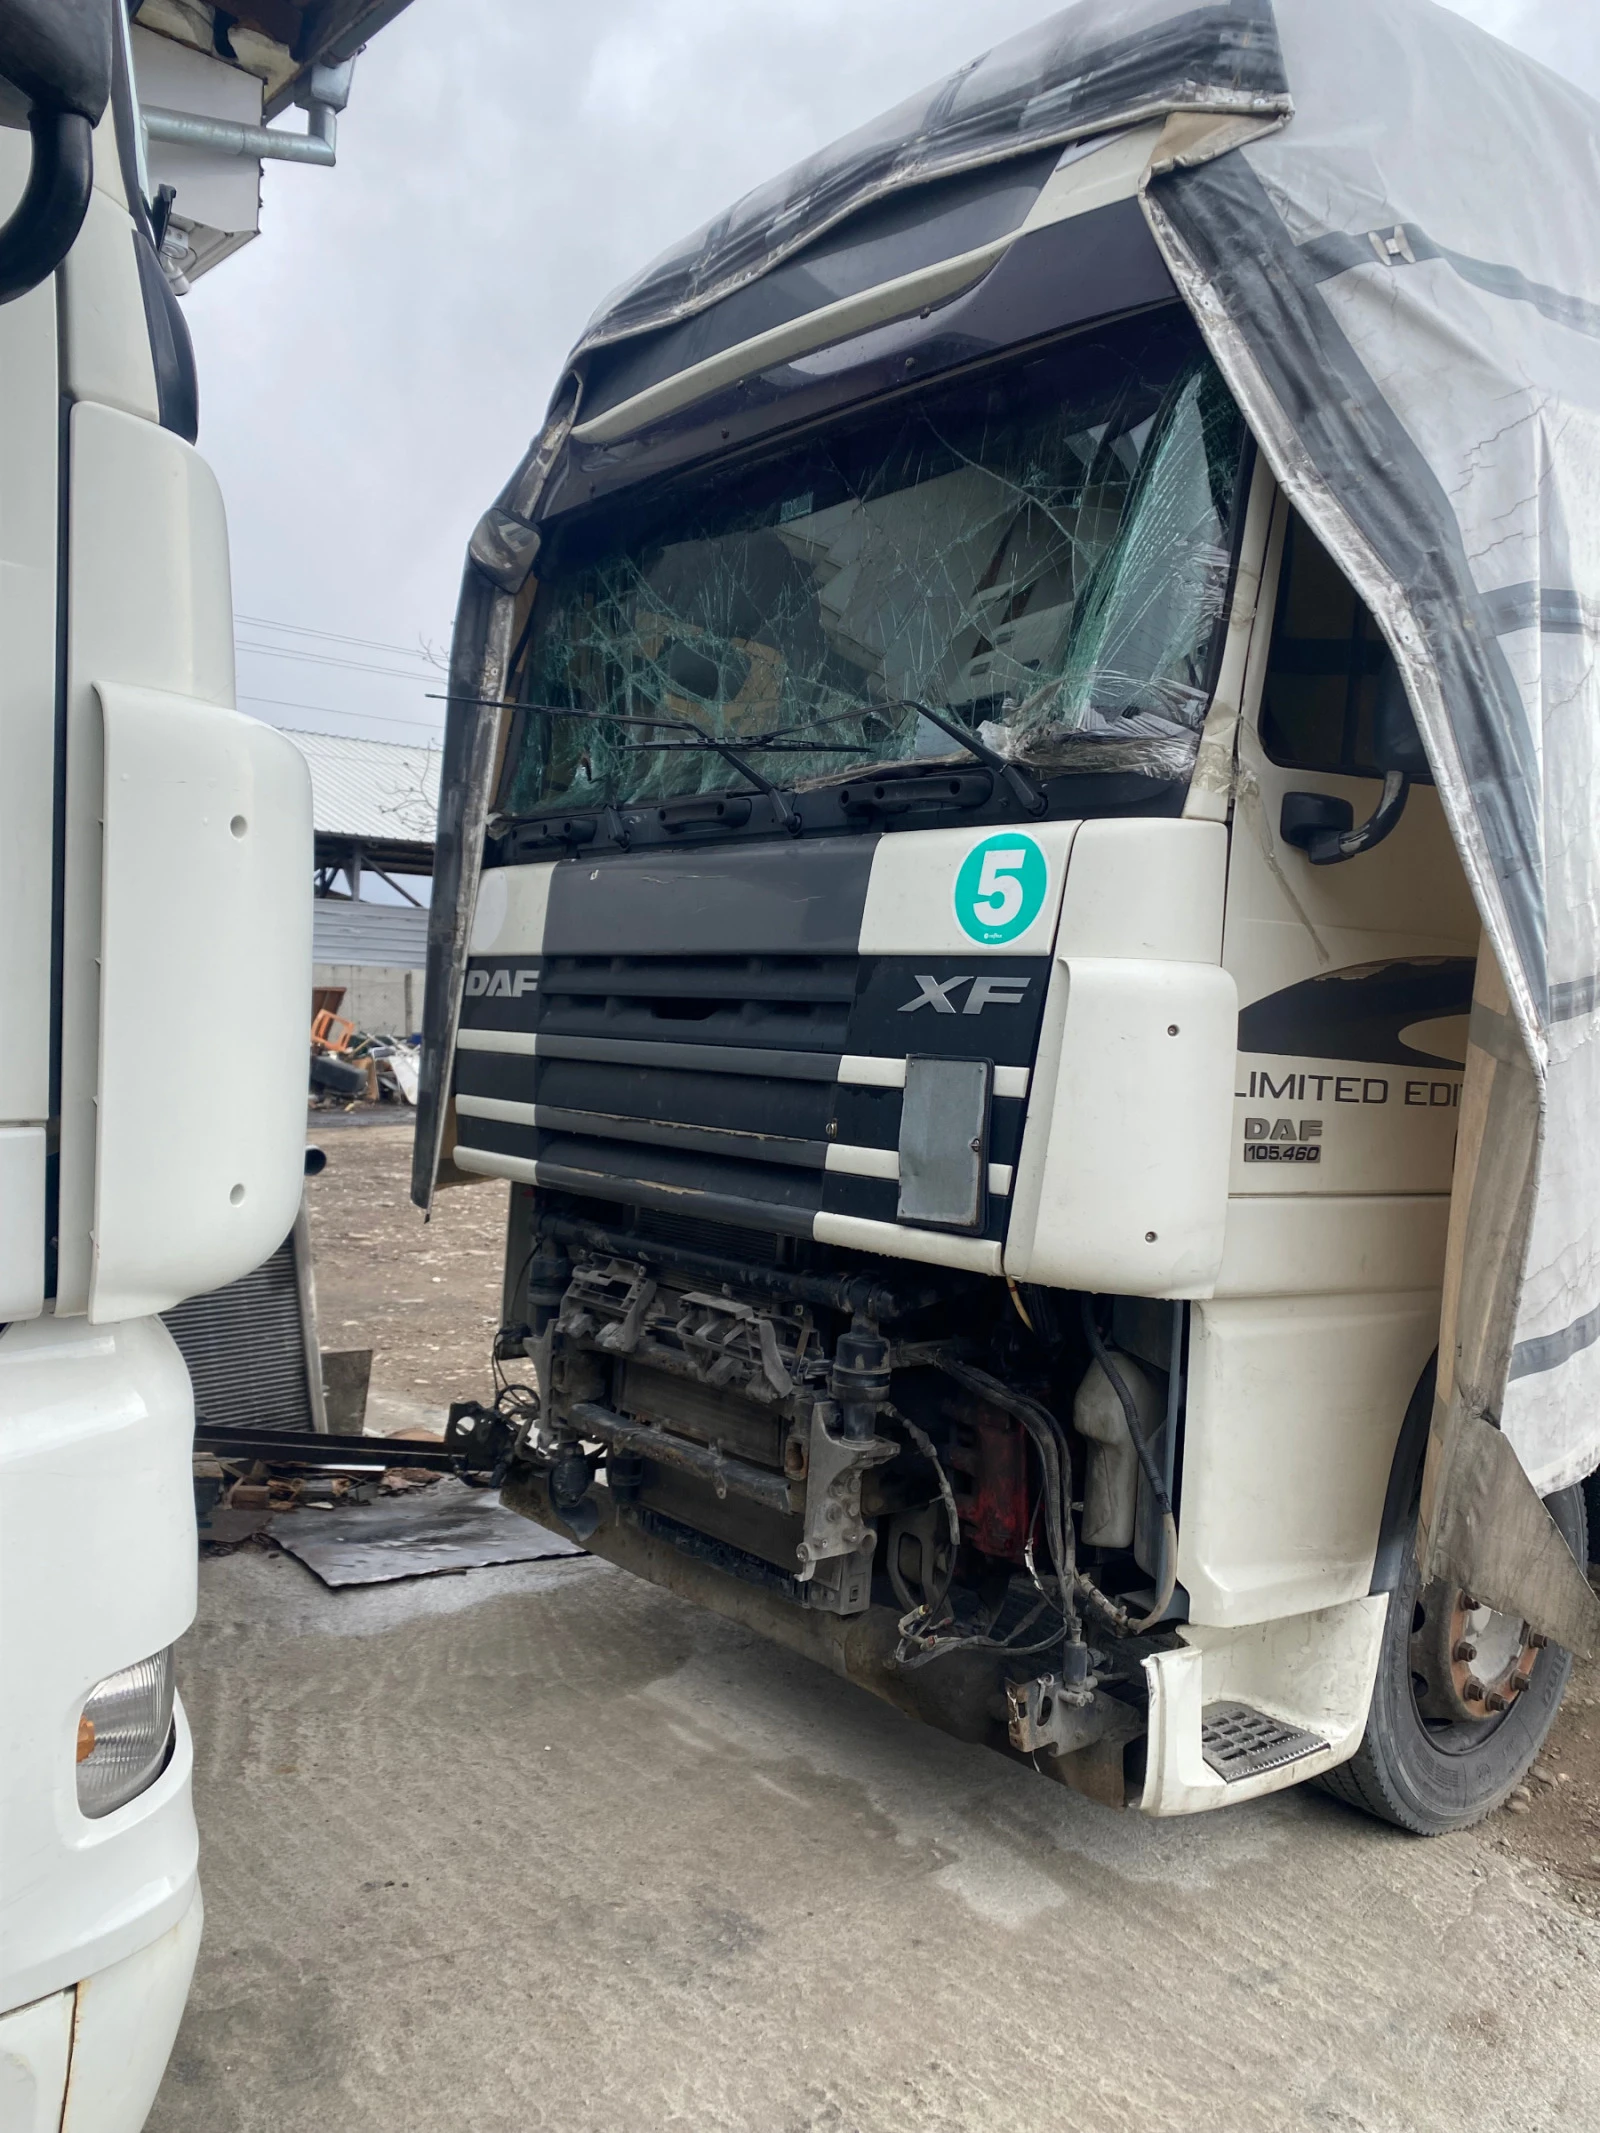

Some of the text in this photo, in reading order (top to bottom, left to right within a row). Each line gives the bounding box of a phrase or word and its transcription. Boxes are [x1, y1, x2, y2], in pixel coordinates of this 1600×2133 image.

[973, 849, 1026, 926] 5
[465, 970, 540, 998] DAF
[897, 975, 1031, 1014] XF
[1404, 1081, 1463, 1107] EDI
[1245, 1118, 1323, 1141] DAF
[1248, 1145, 1319, 1160] 105.460
